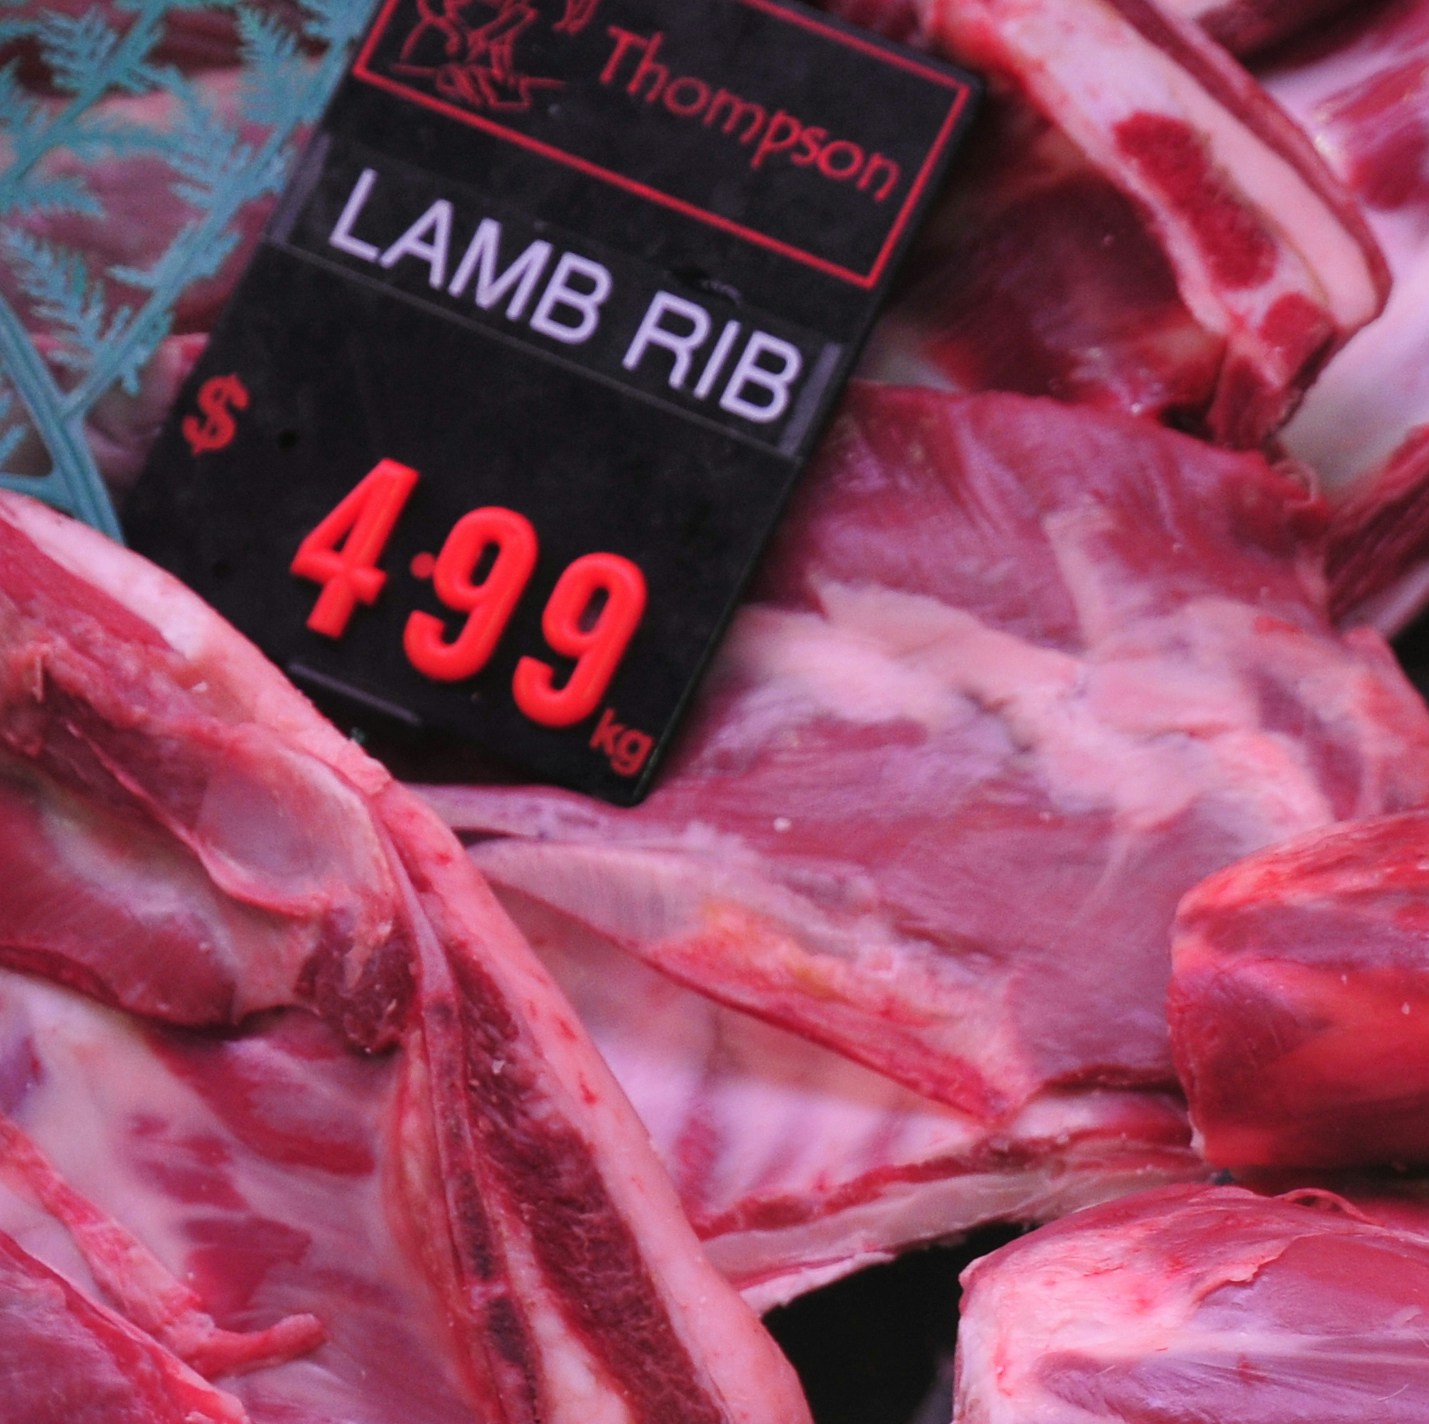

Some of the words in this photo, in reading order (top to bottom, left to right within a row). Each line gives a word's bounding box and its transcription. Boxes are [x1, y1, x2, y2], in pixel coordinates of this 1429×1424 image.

[599, 26, 902, 201] Thompson
[328, 169, 612, 344] LAMB
[622, 291, 801, 424] RIB
[182, 374, 250, 455] $
[589, 707, 654, 777] kg
